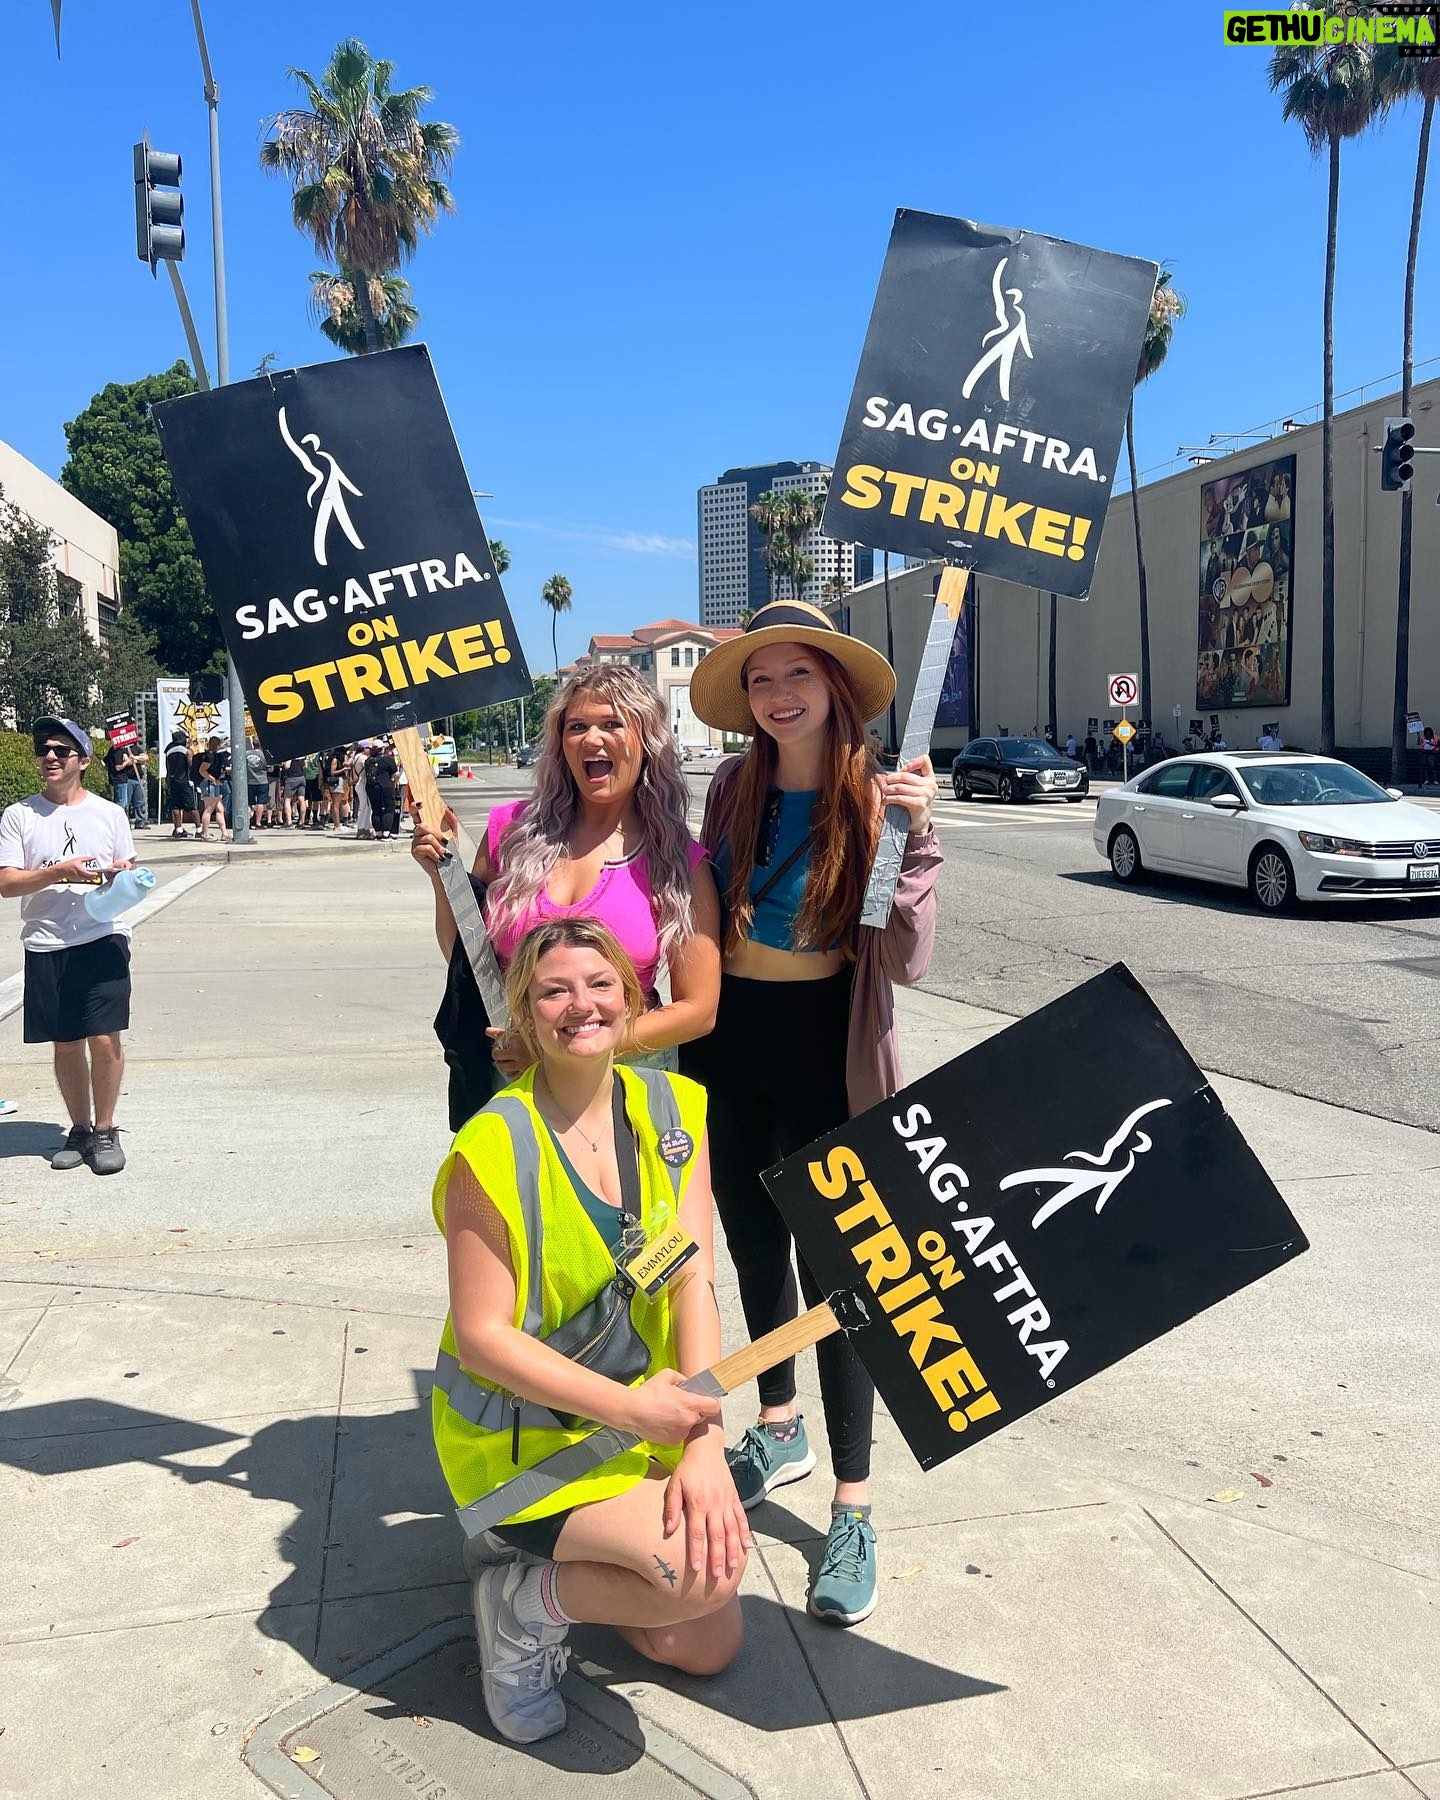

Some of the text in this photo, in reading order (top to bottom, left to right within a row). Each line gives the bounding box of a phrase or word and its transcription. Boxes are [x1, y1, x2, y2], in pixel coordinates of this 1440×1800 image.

[950, 457, 1000, 488] ON
[840, 464, 1092, 561] STRIKE!
[347, 615, 399, 647] ON
[258, 619, 511, 724] STRIKE!
[637, 1232, 684, 1280] EMMYLOU
[917, 1230, 966, 1291] ON
[808, 1145, 1002, 1433] STRIKE!
